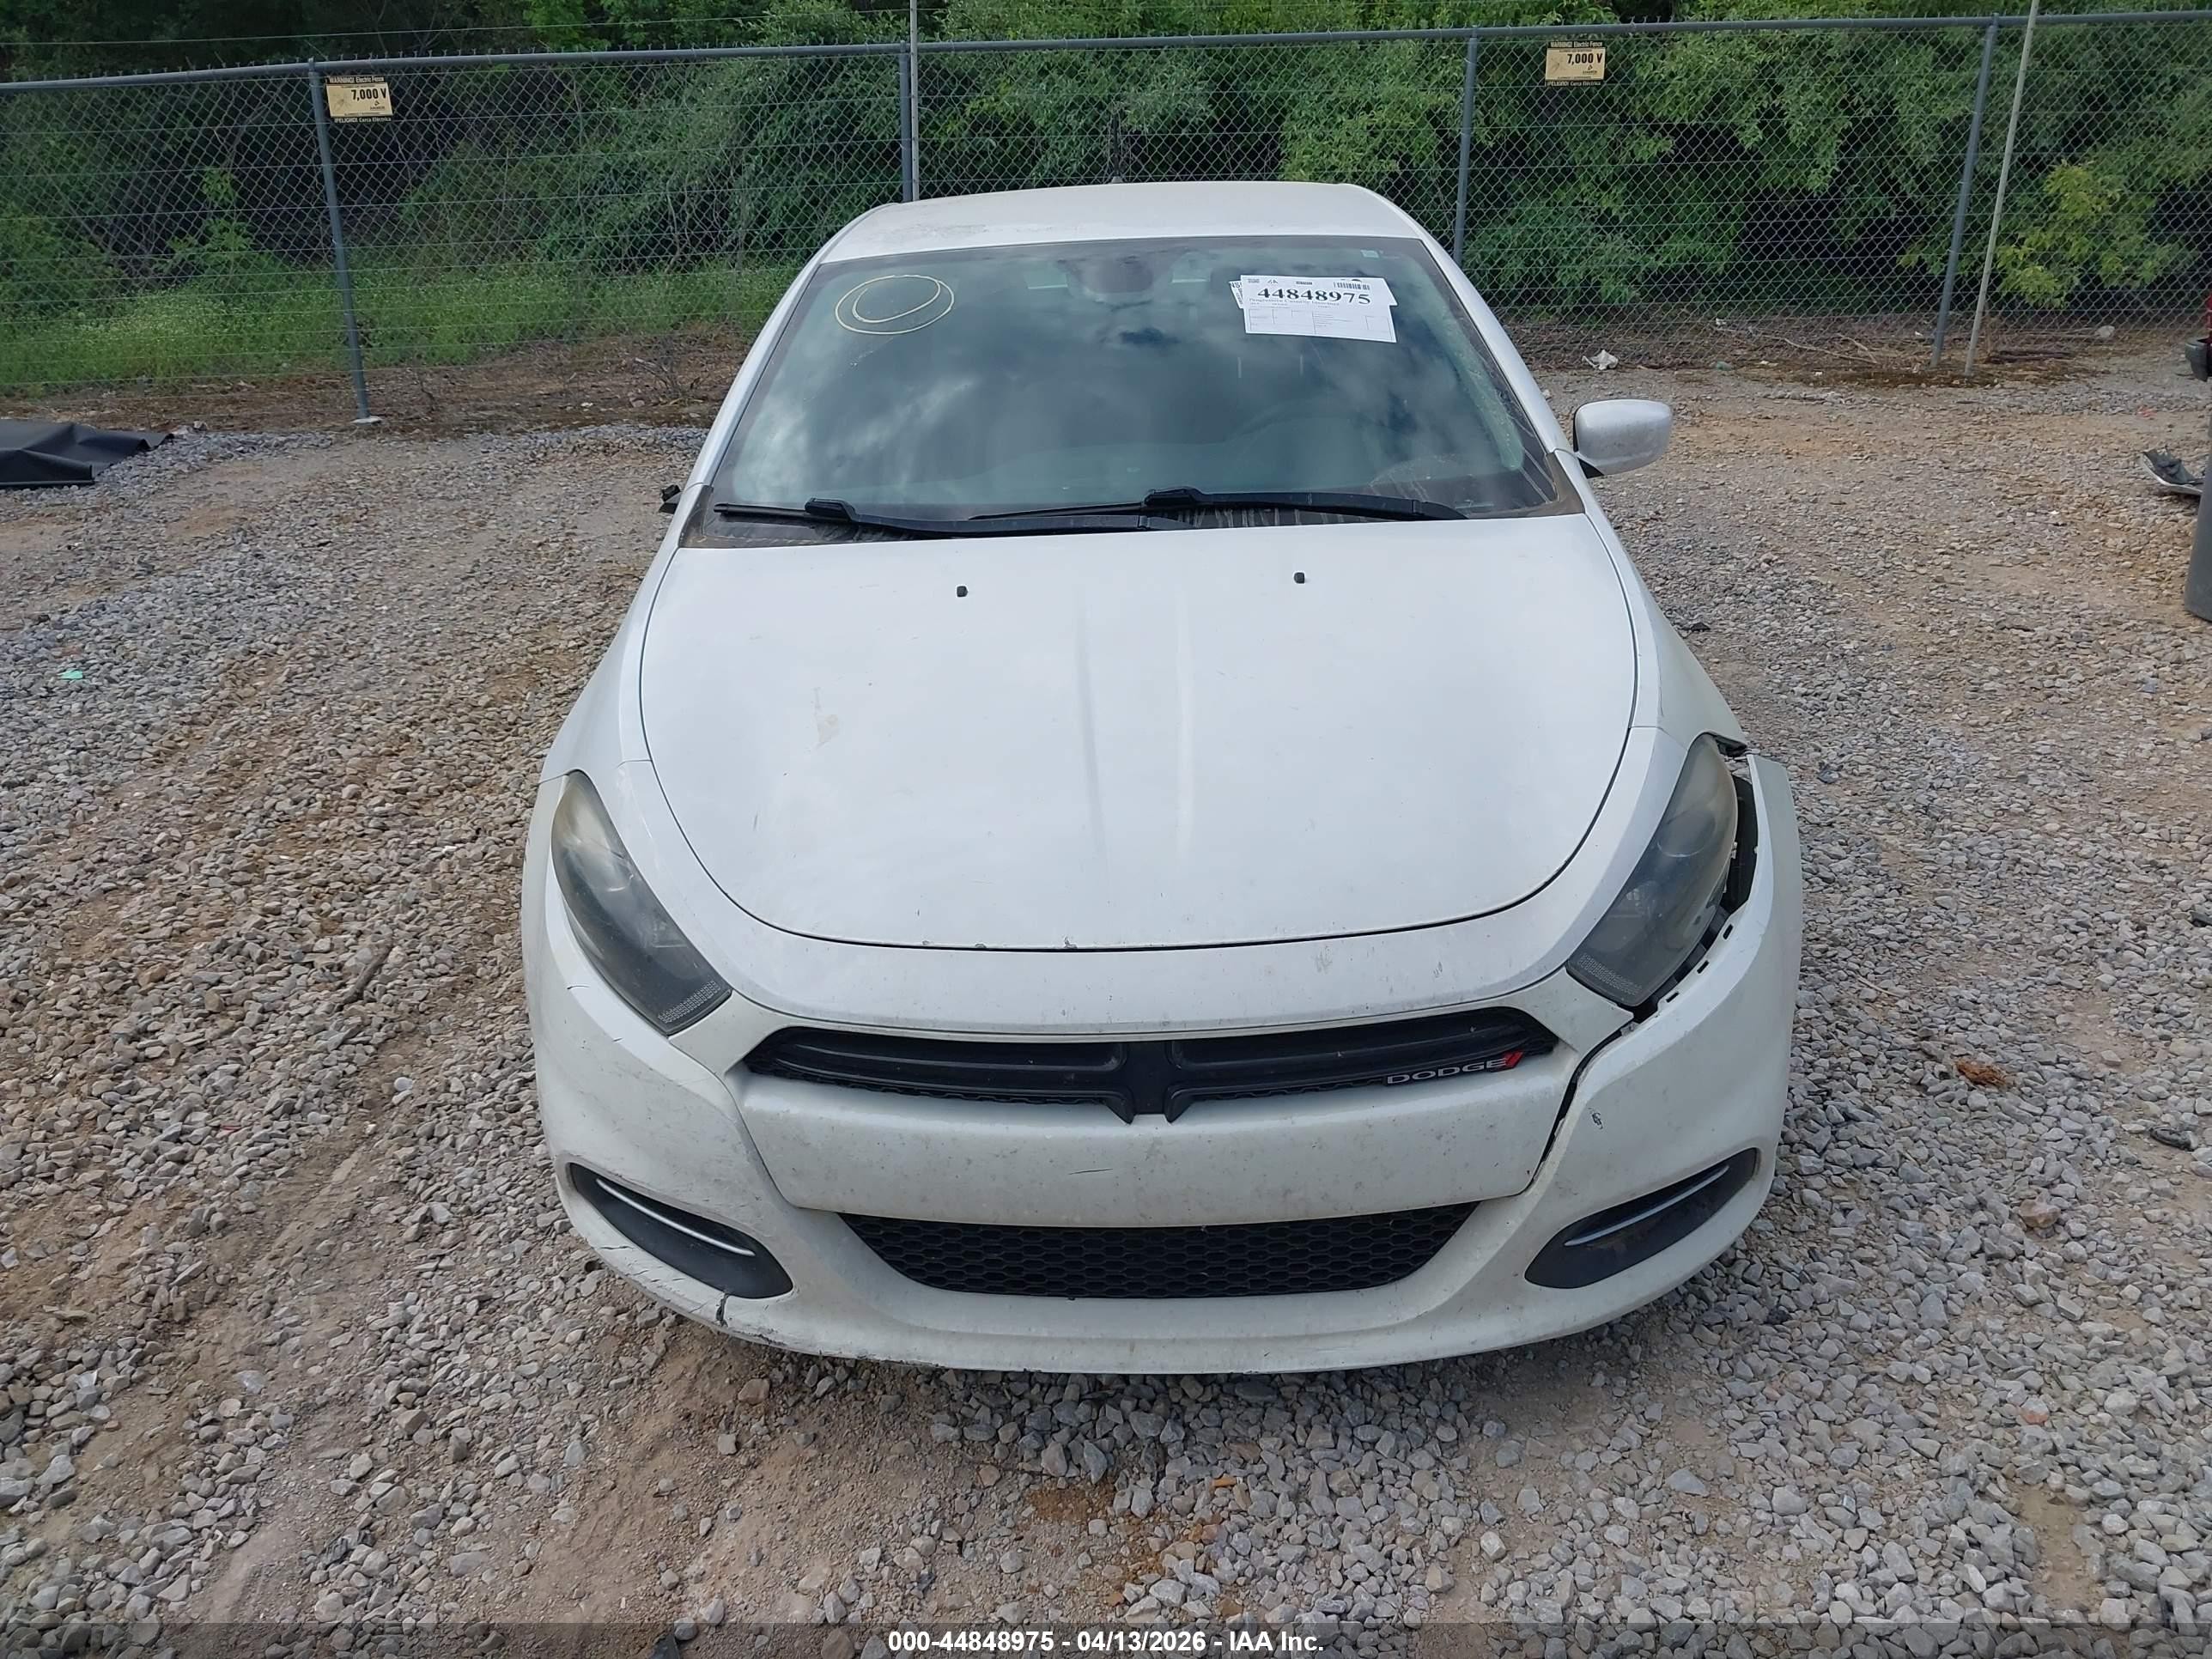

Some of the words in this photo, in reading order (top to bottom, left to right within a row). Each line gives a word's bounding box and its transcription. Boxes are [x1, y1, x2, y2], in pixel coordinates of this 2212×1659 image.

[1567, 53, 1594, 65] 7,000
[1596, 53, 1603, 63] V
[351, 88, 379, 101] 7,000
[380, 88, 386, 99] V
[1257, 288, 1371, 305] 44848975
[1387, 1057, 1508, 1085] DODGE
